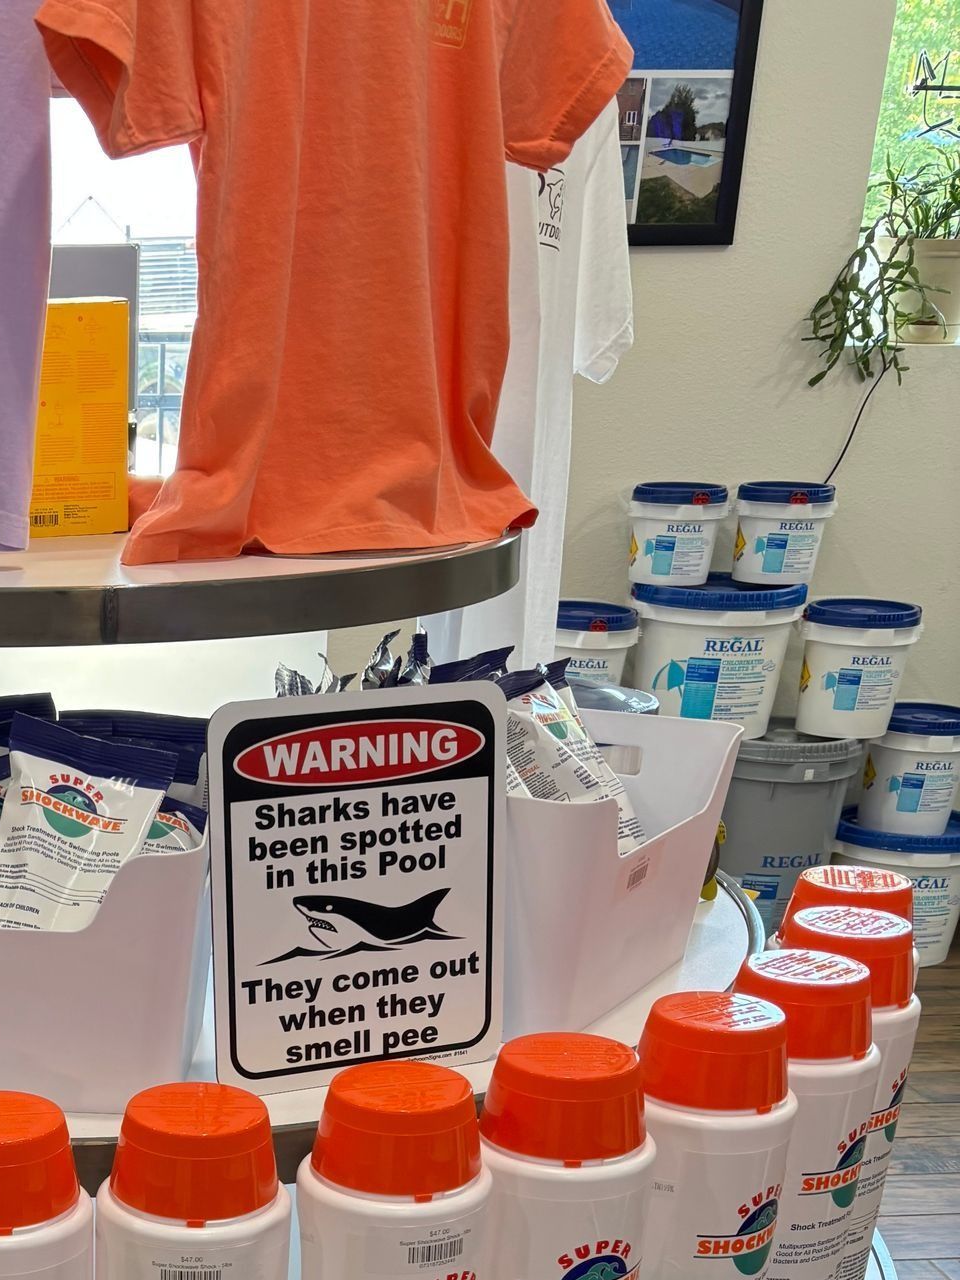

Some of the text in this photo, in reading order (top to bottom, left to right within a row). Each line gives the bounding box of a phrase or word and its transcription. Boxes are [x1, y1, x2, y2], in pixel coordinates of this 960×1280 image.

[667, 524, 703, 533] REGAL
[780, 522, 814, 531] REGAL
[705, 639, 763, 652] REGAL
[569, 660, 608, 669] REGAL
[852, 657, 891, 666] REGAL
[262, 728, 458, 778] WARNING
[916, 762, 953, 770] REGAL
[50, 773, 104, 803] SUPER
[21, 790, 121, 832] SHOCKWAVE
[254, 791, 456, 830] Sharks have
[26, 825, 57, 840] Treatment
[58, 837, 67, 847] For
[248, 814, 462, 861] been spotted
[266, 845, 445, 889] in this Pool
[762, 854, 822, 868] REGAL
[911, 878, 948, 889] EGAL
[242, 951, 480, 1005] They come out
[279, 993, 445, 1032] when they
[286, 1026, 439, 1063] smell pee
[837, 1122, 867, 1153] SUP
[801, 1164, 862, 1192] SHOCK
[790, 1223, 815, 1232] Shock
[557, 1240, 632, 1270] SUPER
